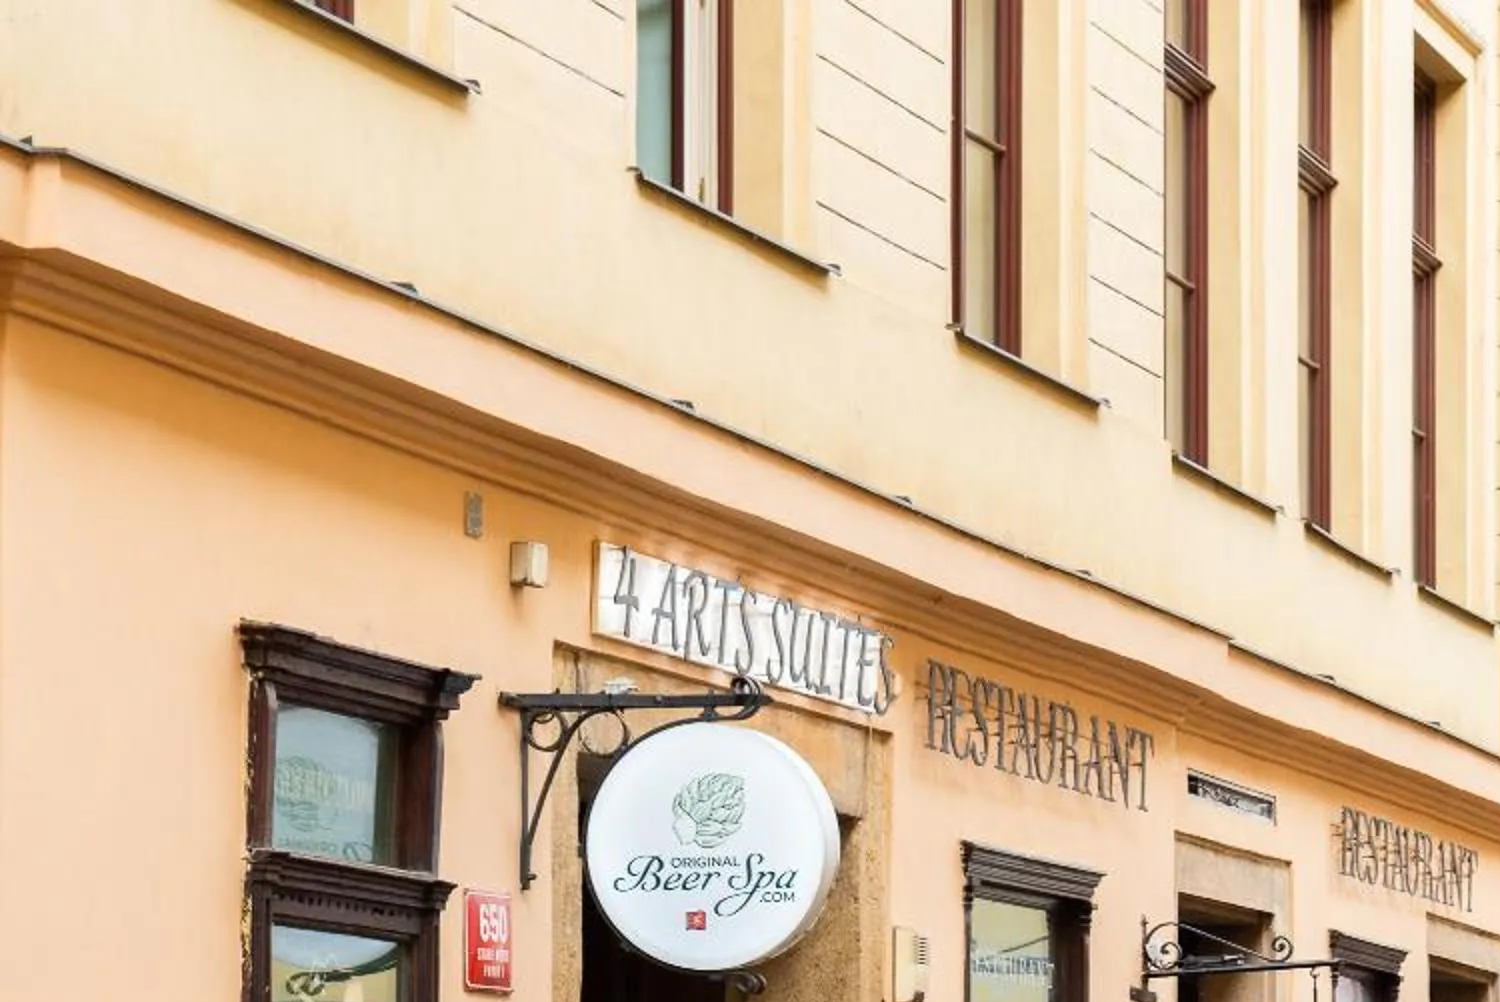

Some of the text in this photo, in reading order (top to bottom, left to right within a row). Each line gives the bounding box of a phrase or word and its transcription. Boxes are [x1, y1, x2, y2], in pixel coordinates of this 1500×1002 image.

[613, 545, 894, 716] 4 ARTS SUITES
[925, 657, 1155, 812] RESTAURANT
[613, 852, 799, 918] Beer Spa
[670, 856, 740, 869] ORIGINAL
[1337, 806, 1479, 912] RESTAURANT
[480, 902, 508, 944] 650
